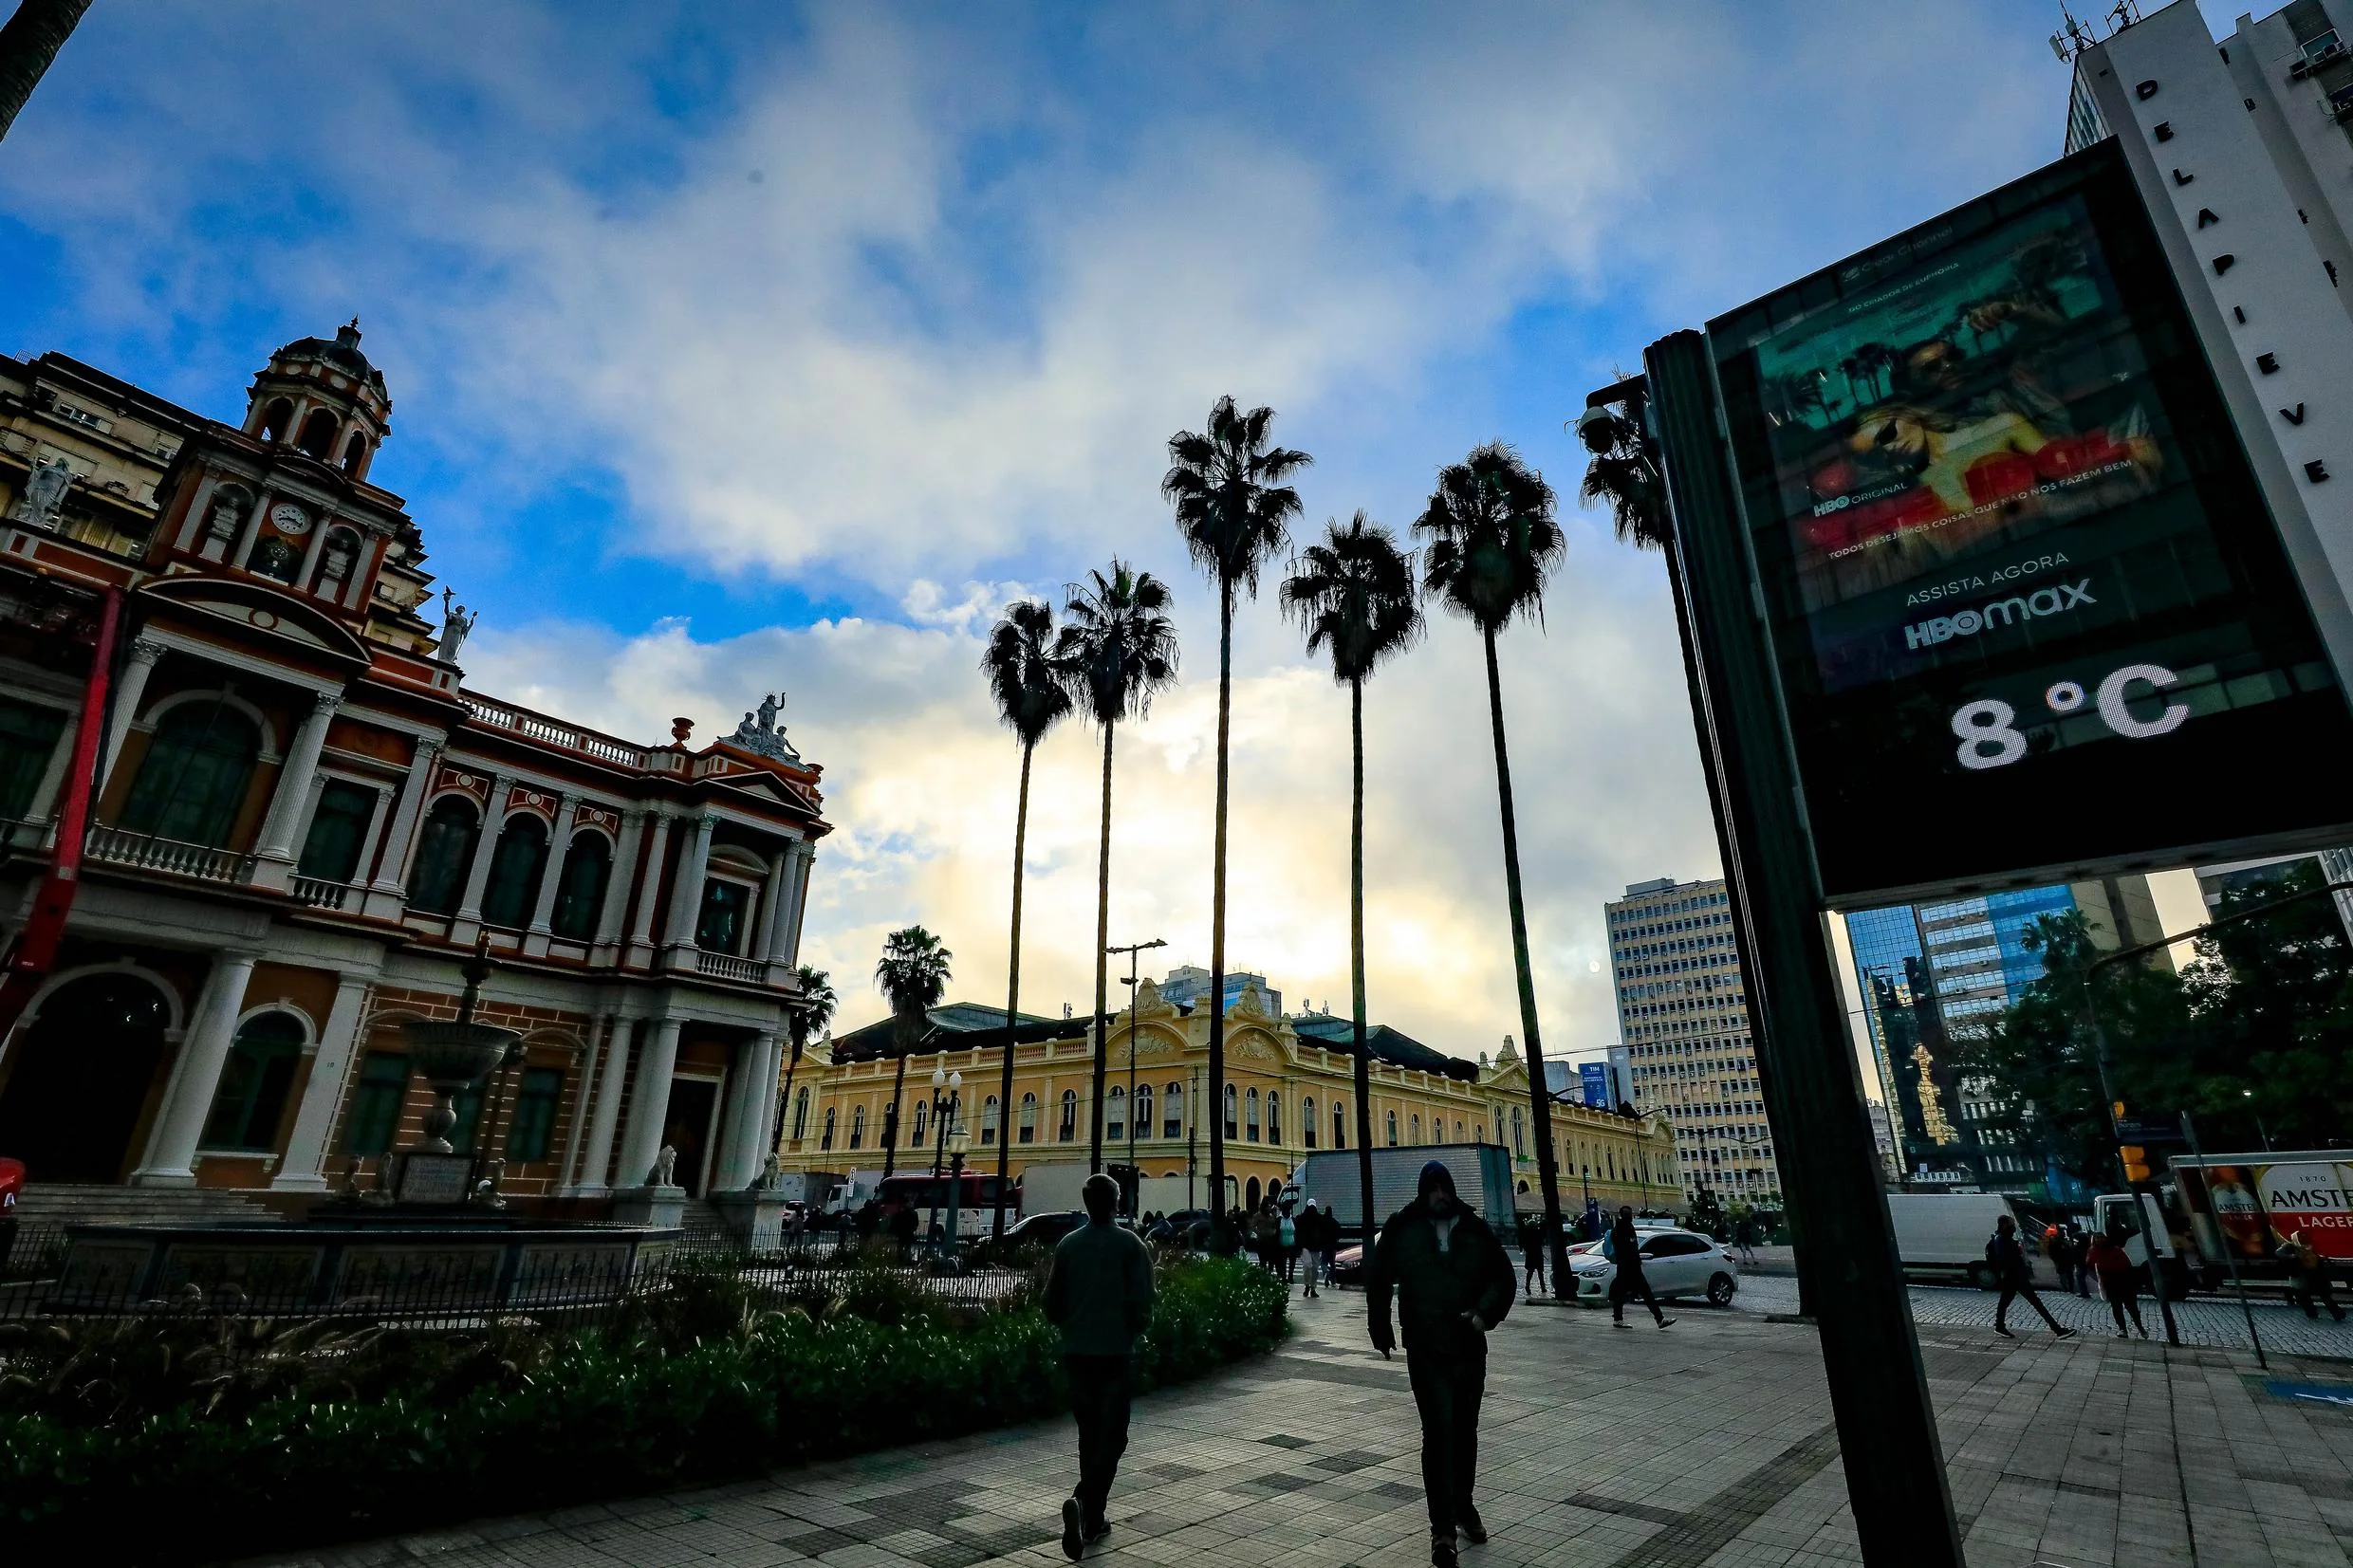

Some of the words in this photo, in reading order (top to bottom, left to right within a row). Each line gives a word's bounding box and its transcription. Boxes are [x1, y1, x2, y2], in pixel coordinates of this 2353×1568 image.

[1813, 495, 1851, 518] HBO
[1851, 482, 1910, 505] ORIGINAL
[1828, 543, 1864, 560] TODOS
[1866, 525, 1930, 547] DESEJAMOS
[1931, 509, 1973, 529] COISAS
[1973, 500, 2002, 515] QUE
[2029, 482, 2058, 497] NOS
[2059, 467, 2103, 487] FAZEM
[2103, 458, 2133, 474] BEM
[1906, 575, 1985, 607] ASSISTA
[1990, 551, 2070, 584] AGORA
